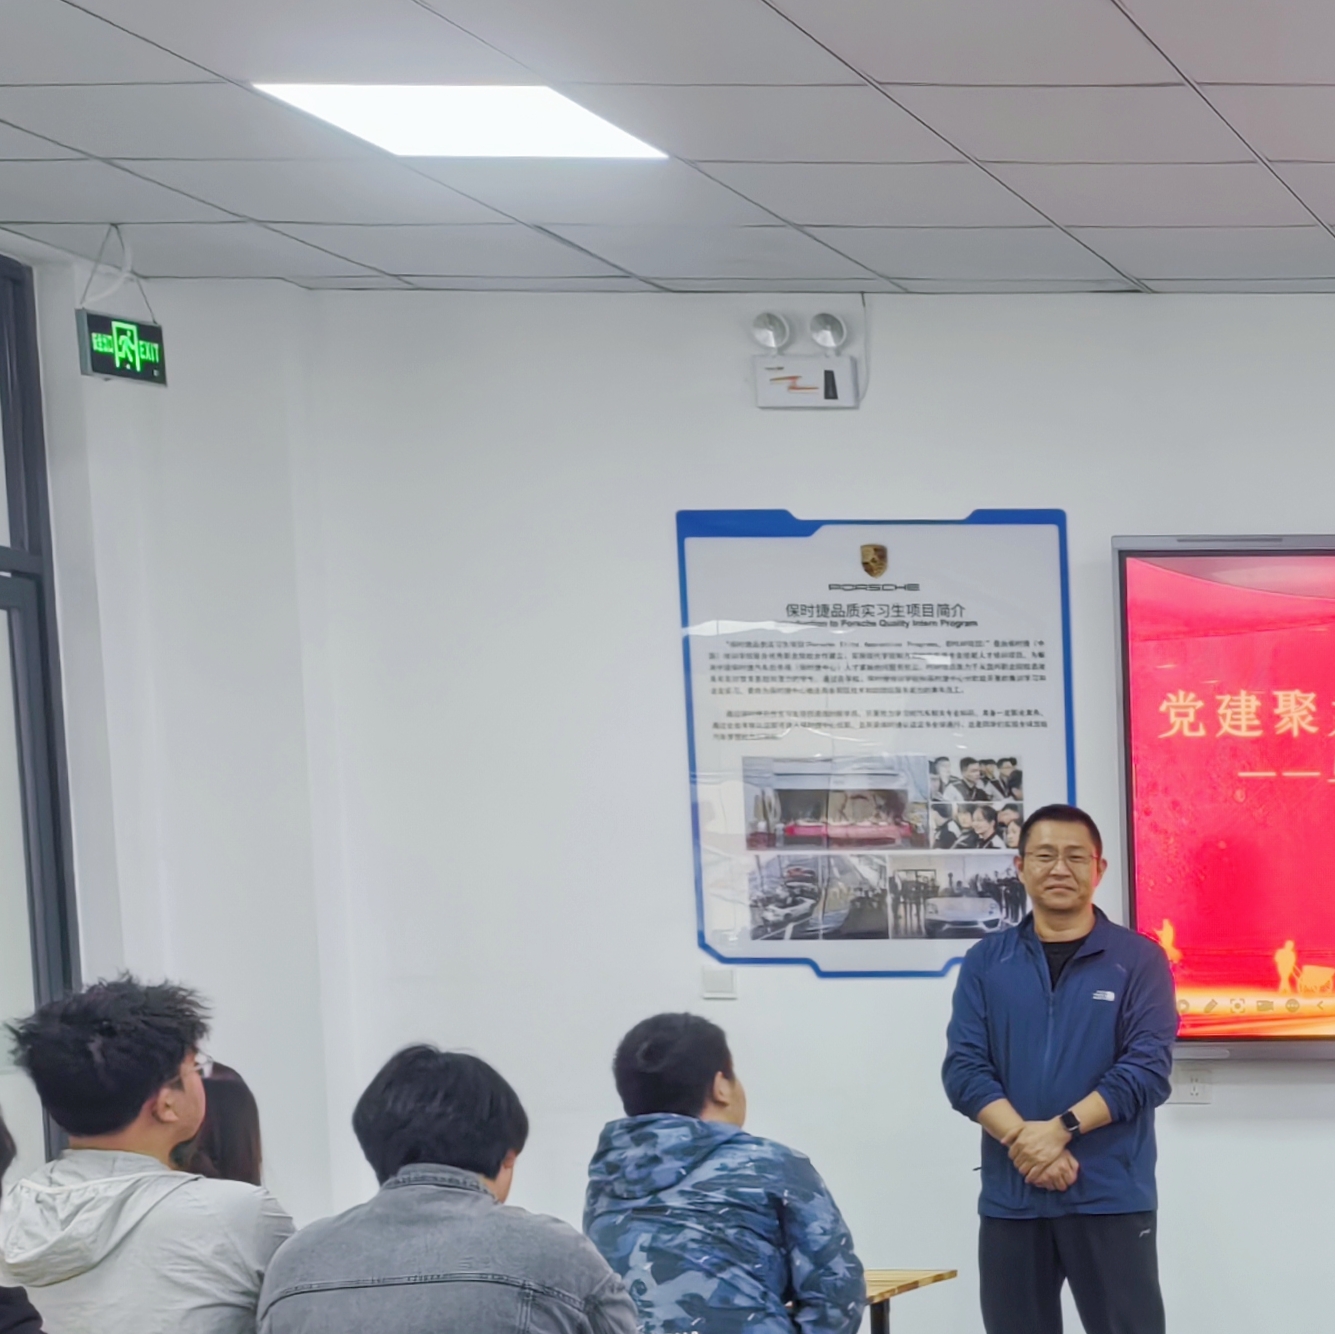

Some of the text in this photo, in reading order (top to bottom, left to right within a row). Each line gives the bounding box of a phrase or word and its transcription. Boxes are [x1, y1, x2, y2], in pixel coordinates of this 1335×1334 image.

[139, 340, 159, 363] EXIT
[828, 583, 920, 591] PORSCHE
[786, 603, 966, 618] 保时捷品质实习生项目简介
[878, 619, 910, 629] Quality
[912, 619, 938, 627] Intern
[939, 619, 979, 629] Program
